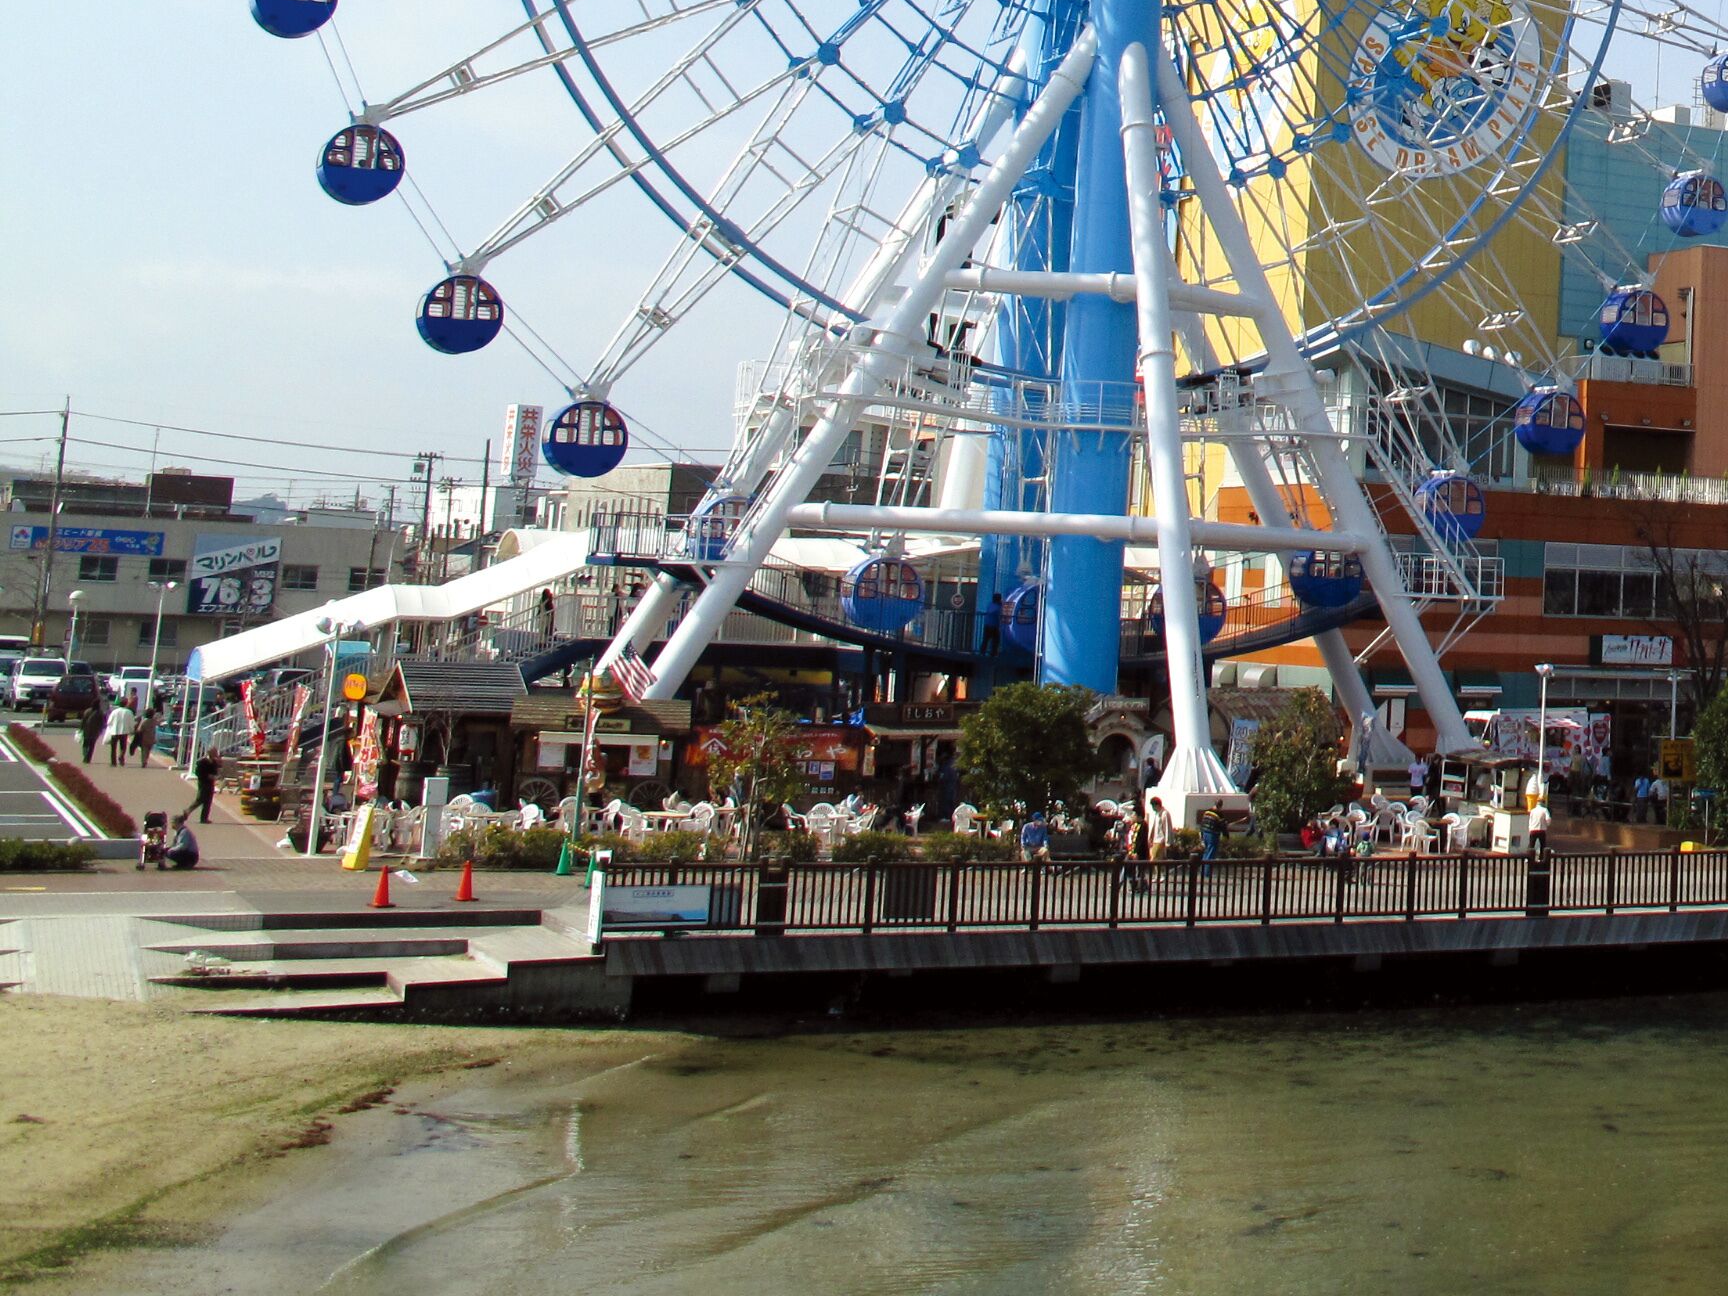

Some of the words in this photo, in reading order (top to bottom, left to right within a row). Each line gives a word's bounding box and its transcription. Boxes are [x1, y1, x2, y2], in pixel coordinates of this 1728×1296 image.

[1396, 136, 1481, 174] DRAM
[1488, 61, 1536, 141] PLAZA
[517, 408, 538, 472] 共栄火災
